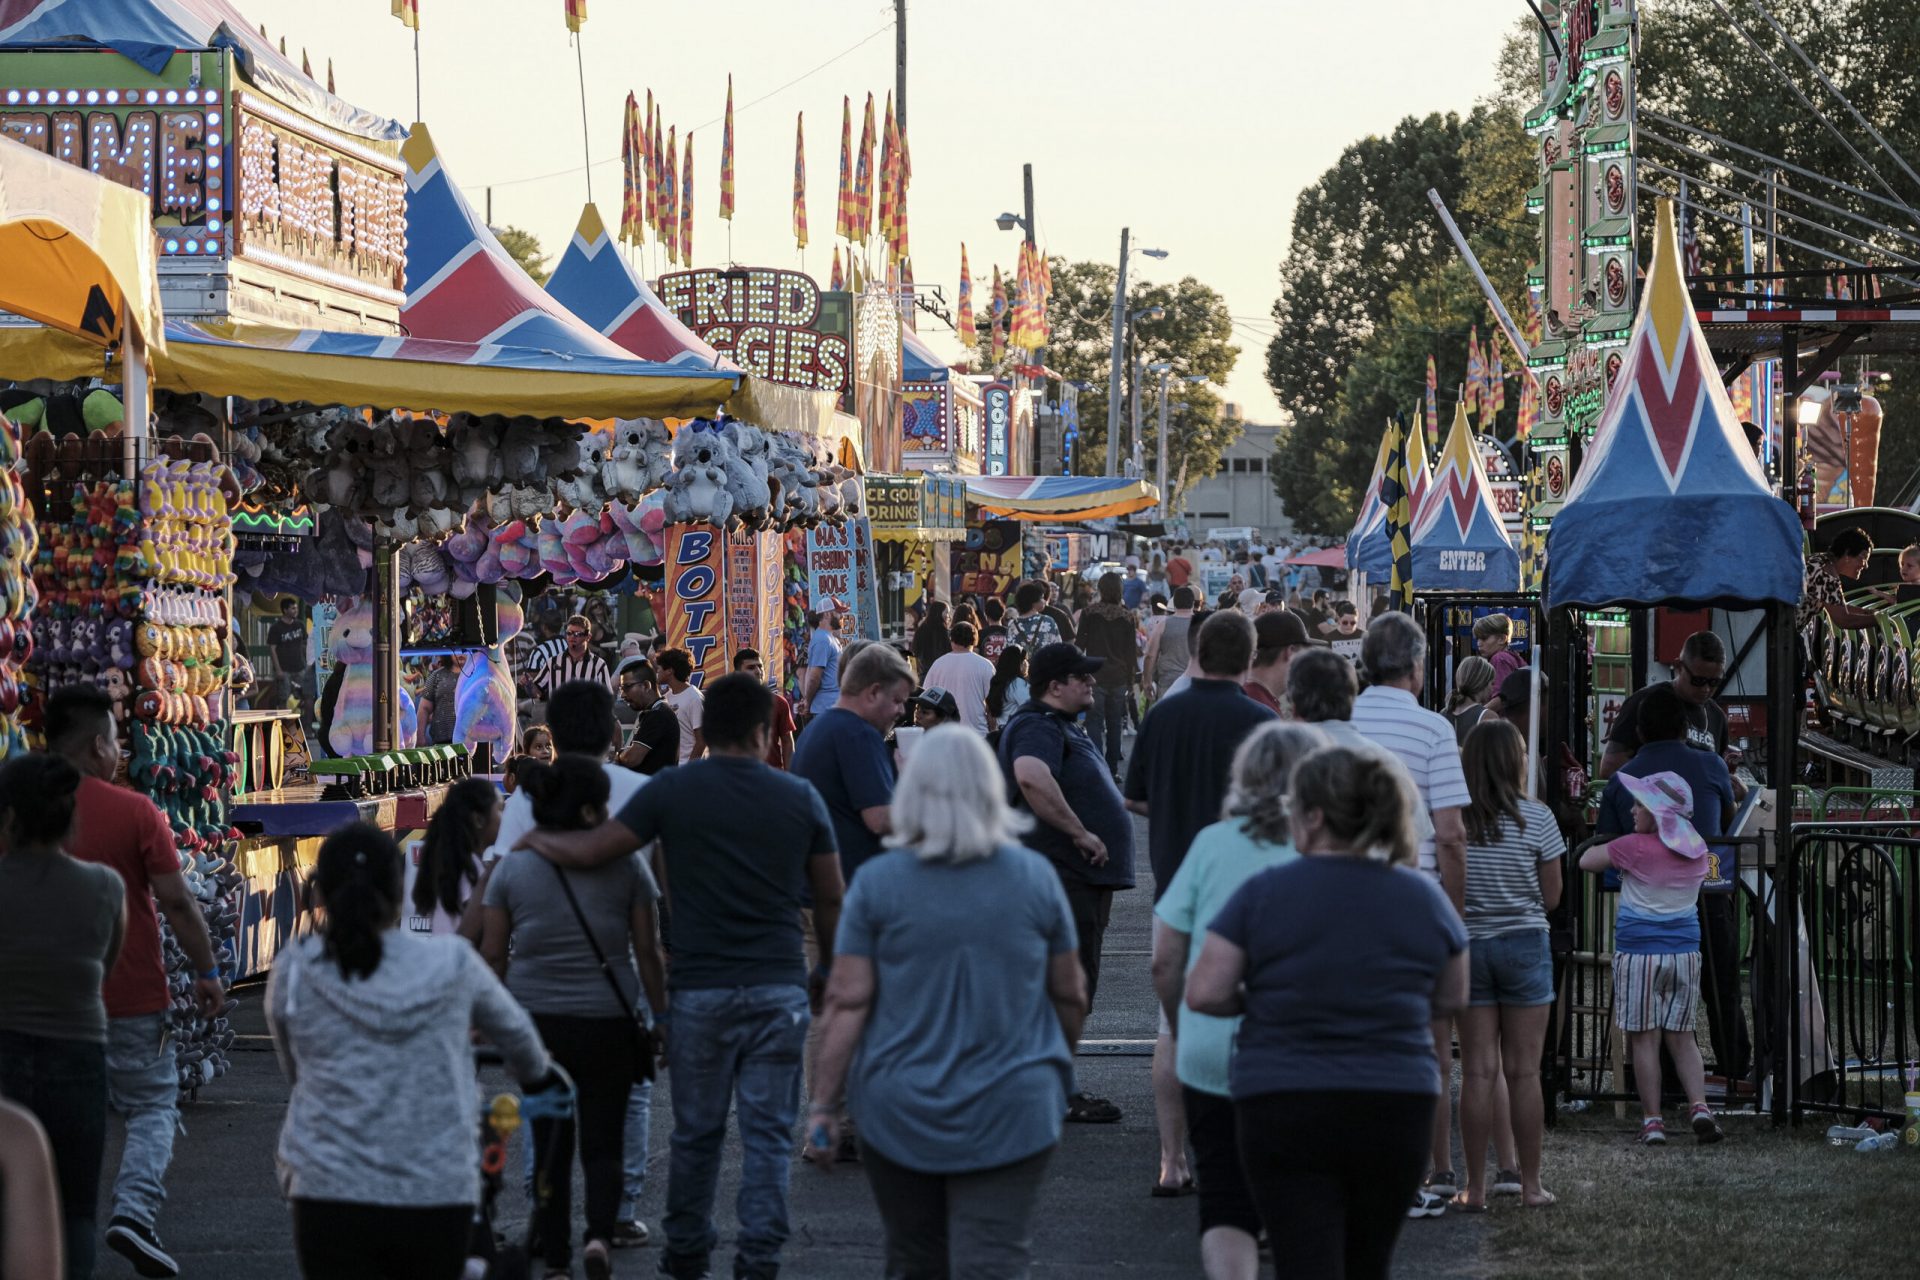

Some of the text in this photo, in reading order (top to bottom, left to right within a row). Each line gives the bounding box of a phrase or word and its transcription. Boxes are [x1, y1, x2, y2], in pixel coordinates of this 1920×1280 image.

[0, 110, 205, 222] IME
[661, 270, 819, 327] FRIED
[702, 325, 848, 392] GGIES
[903, 398, 941, 438] OX
[991, 392, 1005, 456] CORN
[866, 487, 920, 502] CE COLD
[867, 505, 918, 520] DRINKS
[811, 549, 852, 571] FISHIN'
[1439, 550, 1486, 572] ENTER
[818, 574, 848, 595] HOLE
[676, 531, 716, 690] BOTT
